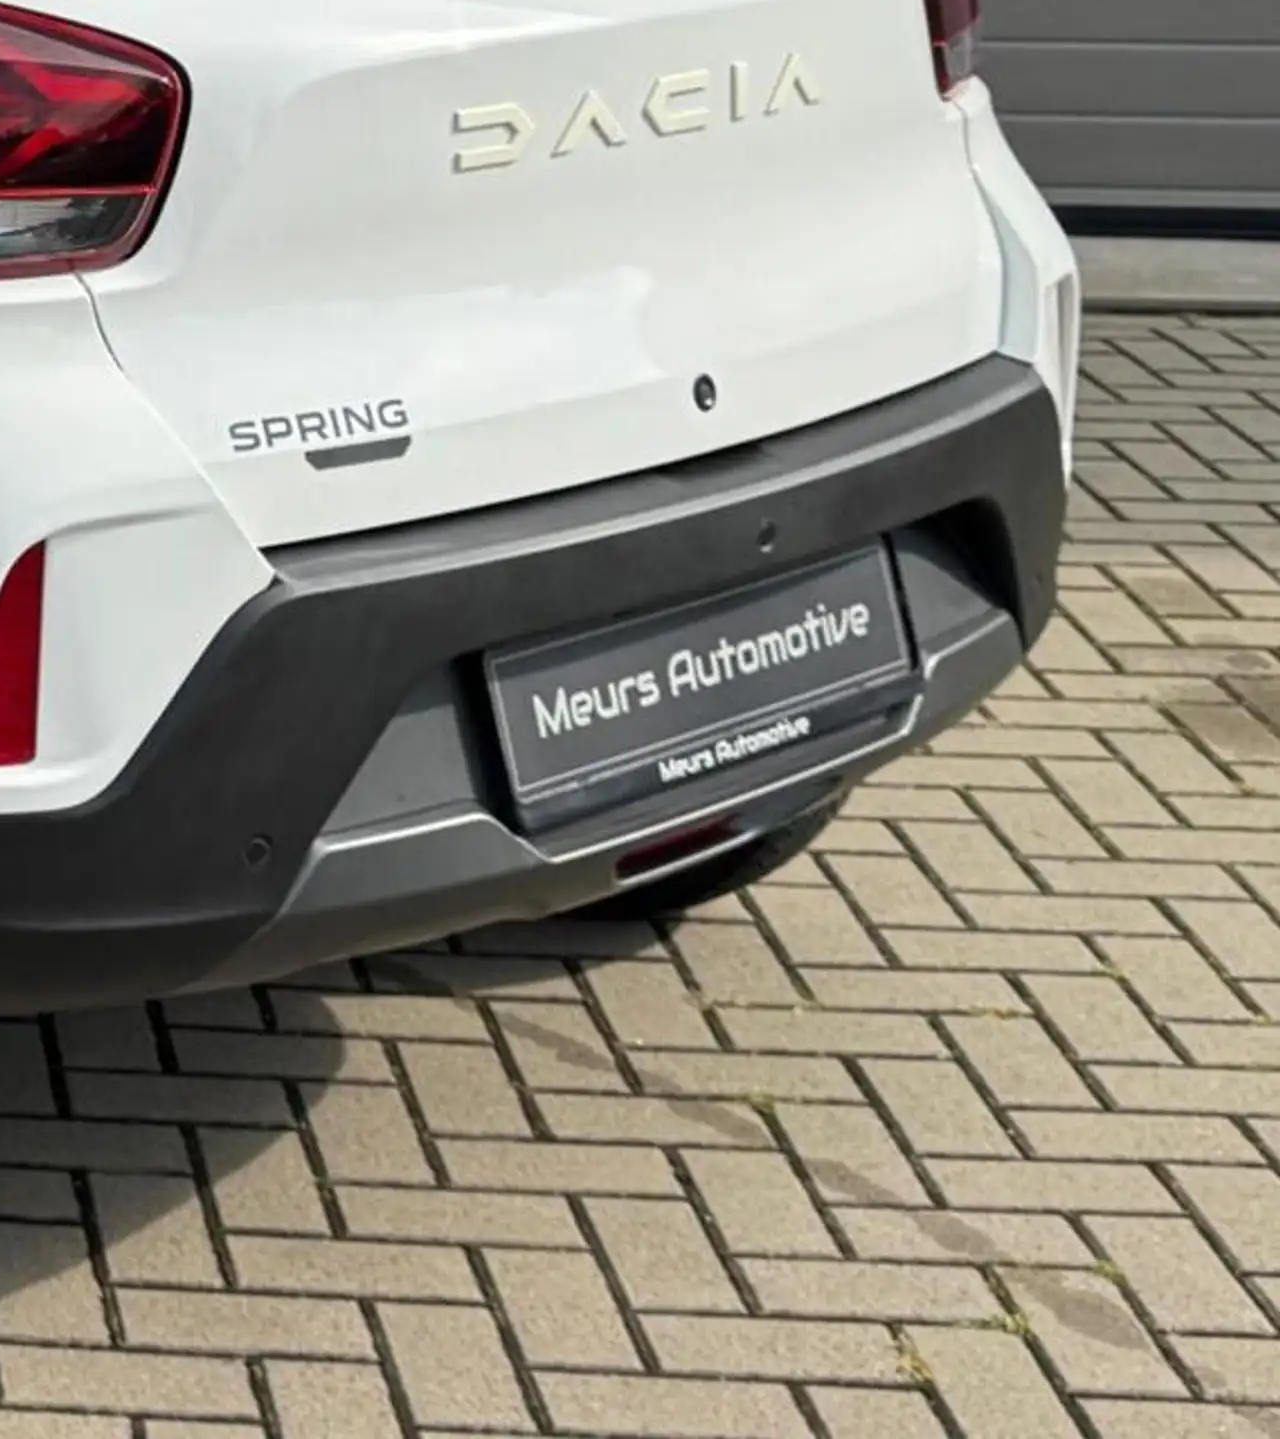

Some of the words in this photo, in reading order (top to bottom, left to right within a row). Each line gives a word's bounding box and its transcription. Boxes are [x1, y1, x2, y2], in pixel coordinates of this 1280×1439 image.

[449, 52, 822, 174] DACIA
[227, 399, 410, 454] SPRING
[532, 670, 661, 740] Meurs
[666, 601, 871, 698] Automotive
[658, 748, 715, 784] Meurs
[715, 716, 812, 765] Automotive
